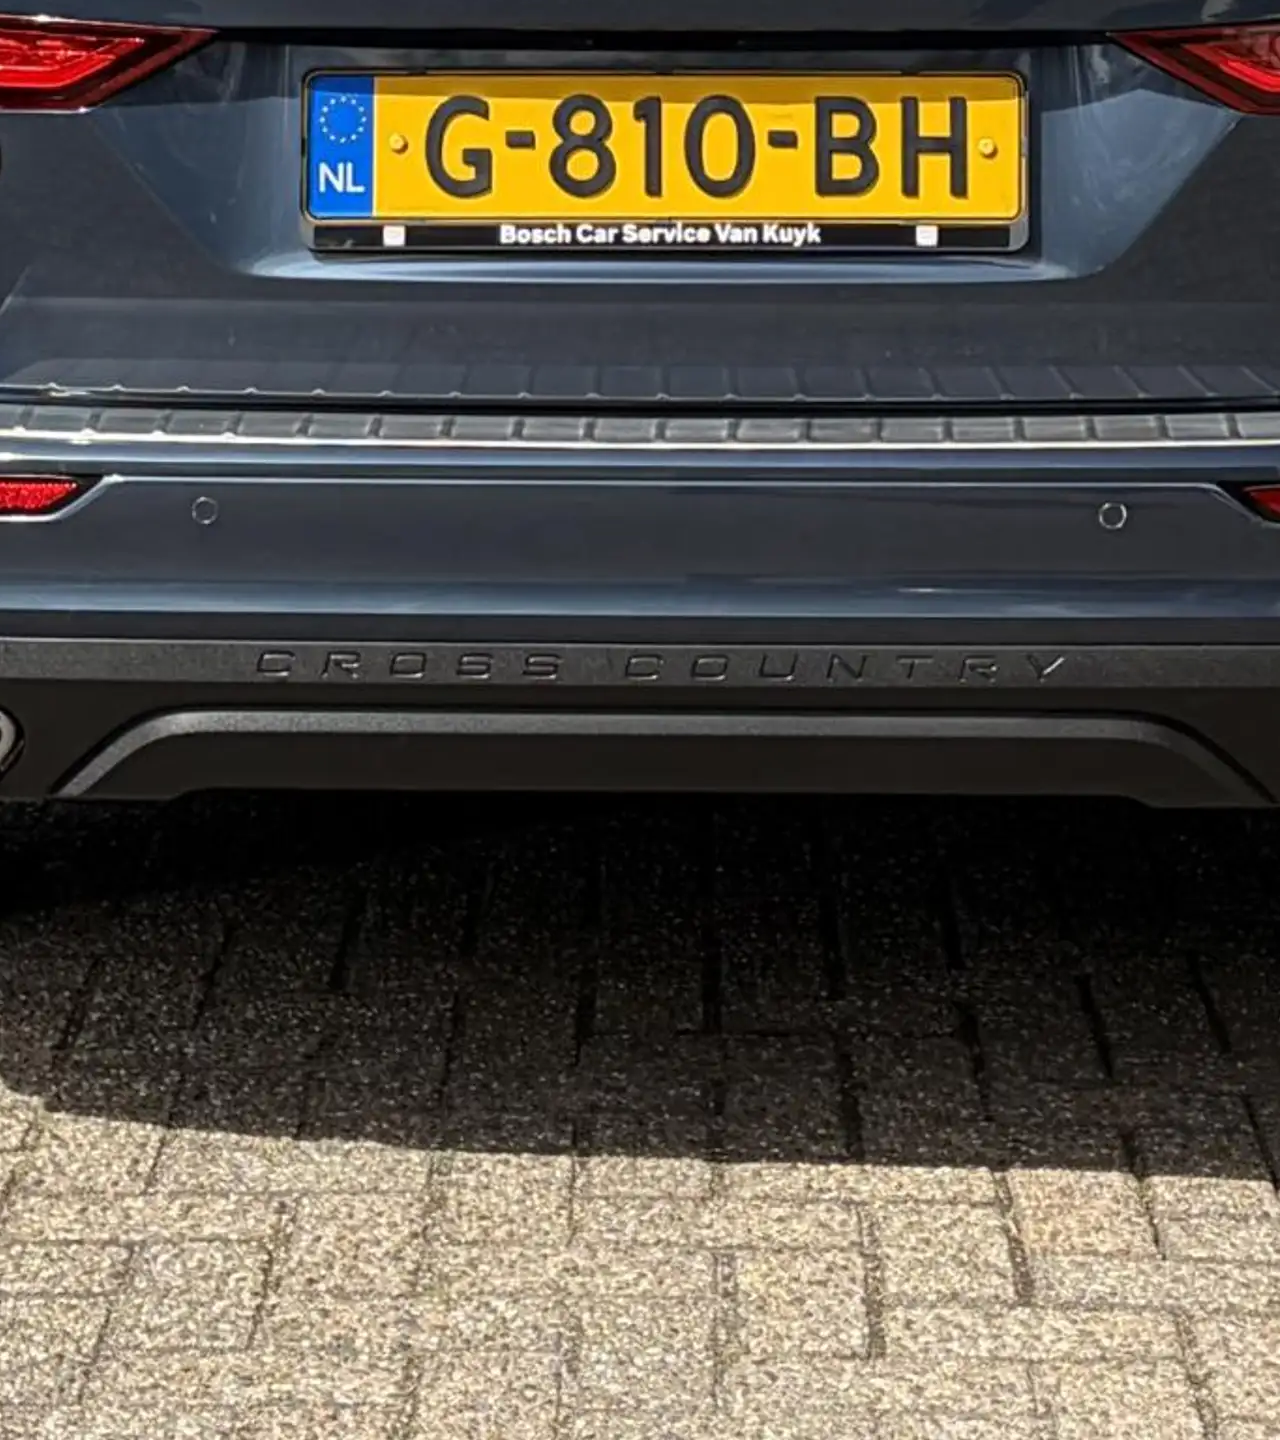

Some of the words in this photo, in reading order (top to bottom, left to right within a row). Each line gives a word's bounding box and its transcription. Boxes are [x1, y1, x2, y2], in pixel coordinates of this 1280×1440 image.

[319, 162, 365, 193] NL
[424, 92, 969, 200] G-810-BH
[499, 224, 572, 244] Bosch
[576, 225, 619, 244] Car
[621, 224, 711, 244] Service
[715, 225, 758, 244] Van
[762, 223, 822, 247] Kuyk
[256, 651, 564, 680] CROSS
[624, 652, 1066, 684] COUNTRY
